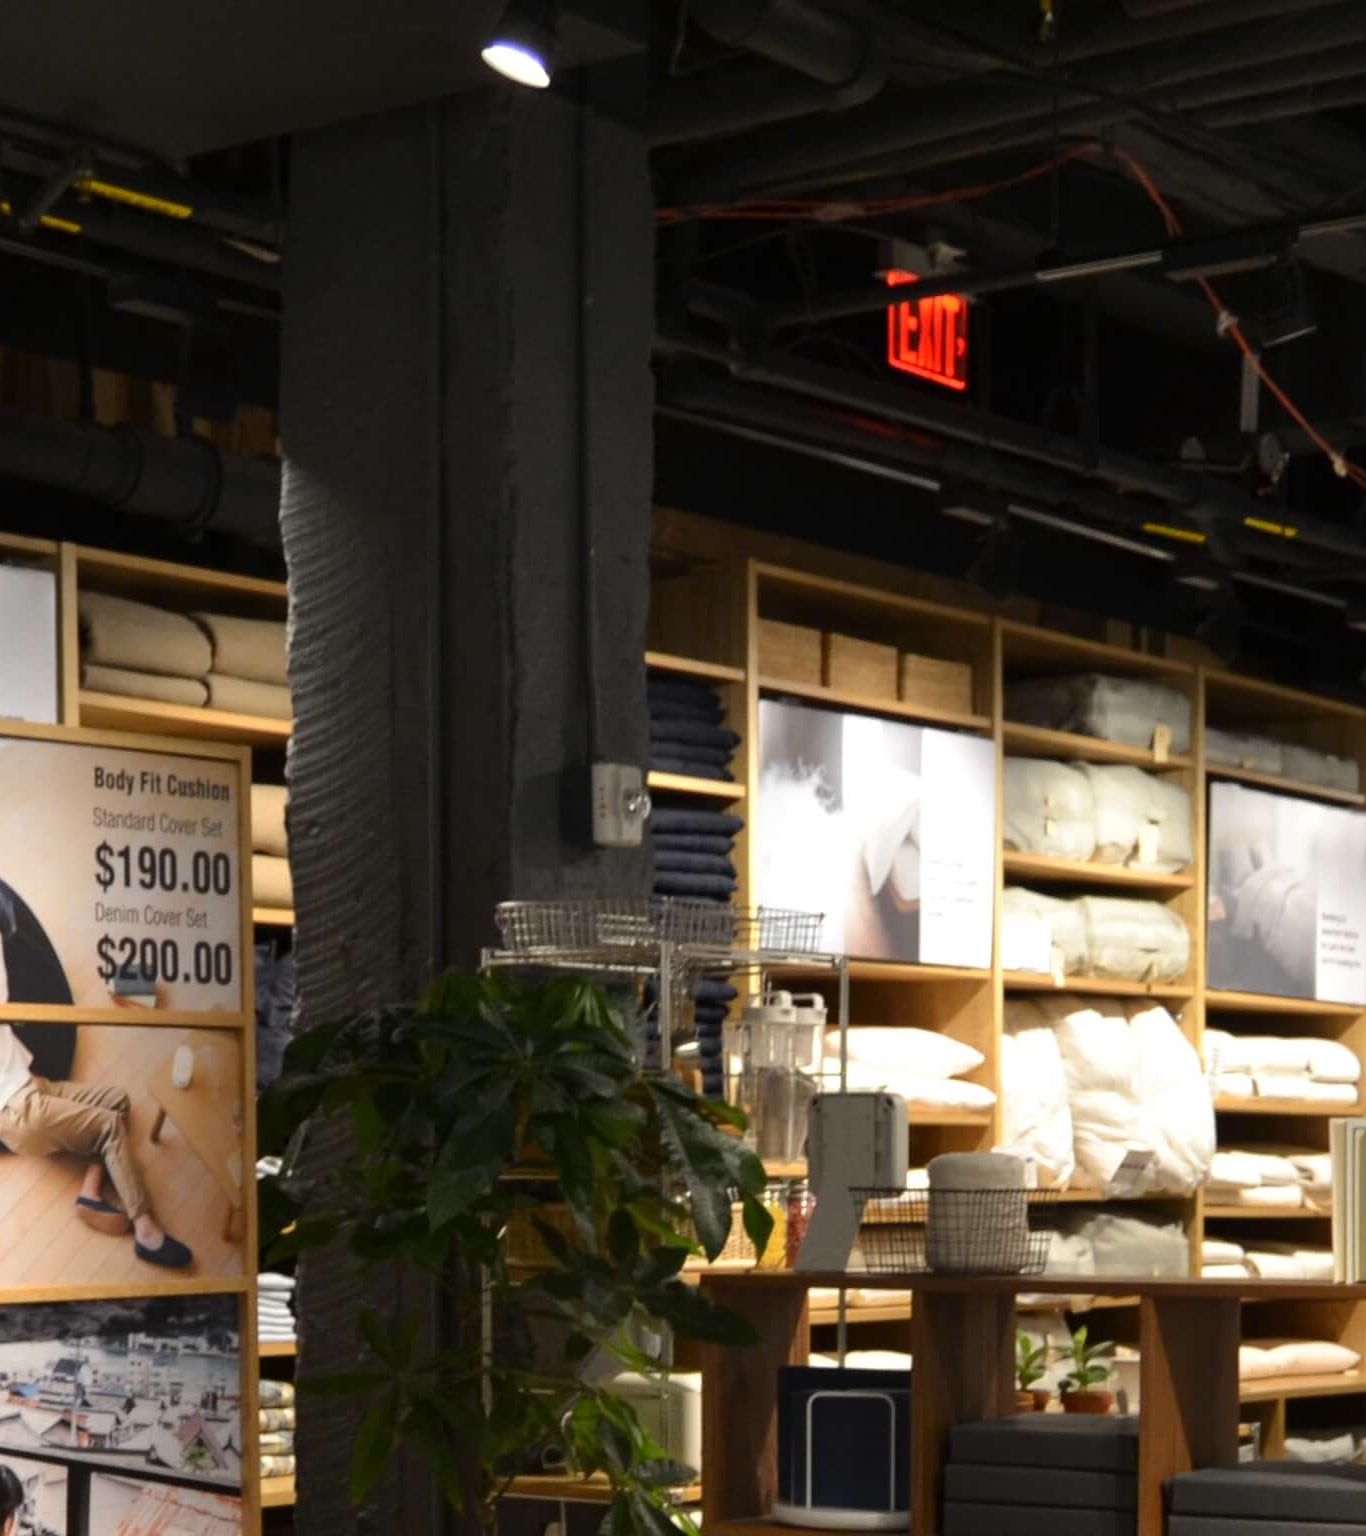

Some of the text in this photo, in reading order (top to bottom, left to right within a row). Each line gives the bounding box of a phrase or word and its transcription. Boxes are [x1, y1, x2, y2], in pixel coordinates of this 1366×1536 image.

[899, 295, 959, 377] EXIT
[94, 766, 230, 801] Body Fit Cushion
[93, 806, 222, 839] Standard Cover Set
[95, 840, 231, 896] $190.00
[94, 902, 207, 929] Denim Cover Set
[97, 933, 232, 986] $200.00
